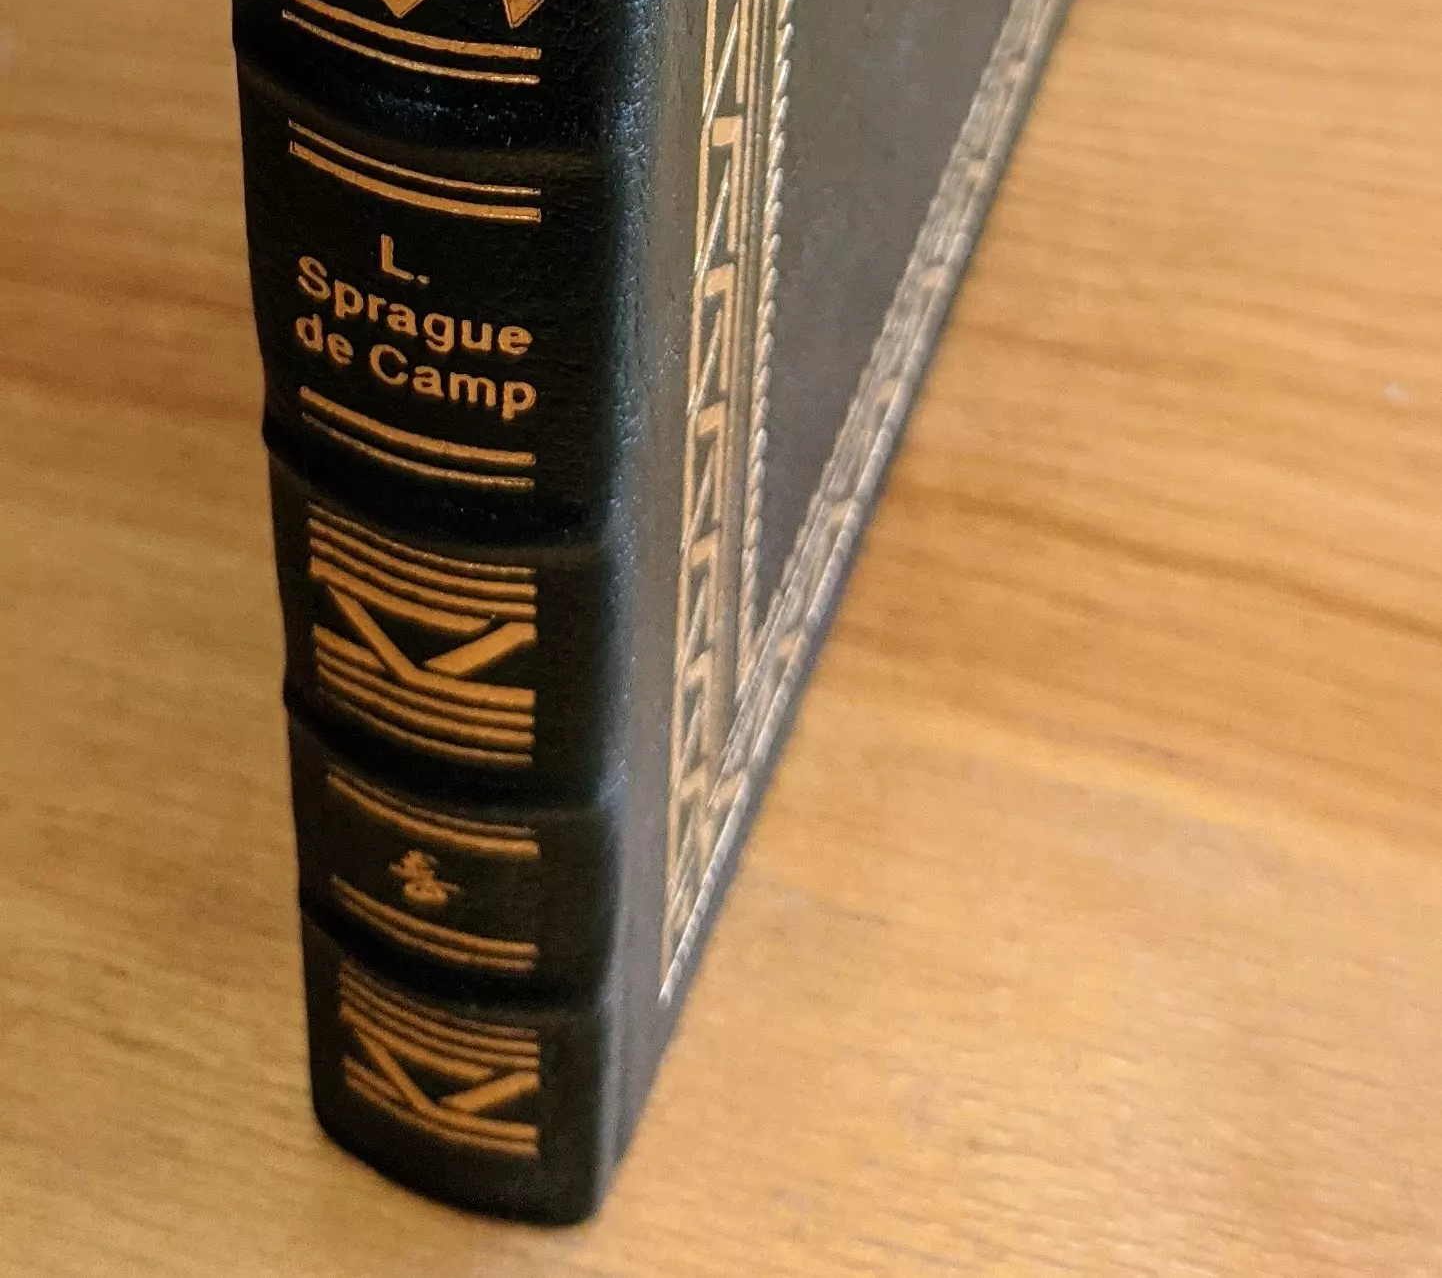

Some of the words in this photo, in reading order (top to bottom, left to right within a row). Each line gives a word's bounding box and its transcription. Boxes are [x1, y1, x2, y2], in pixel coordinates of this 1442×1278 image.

[297, 255, 533, 356] Sprague
[380, 233, 430, 285] L.
[295, 313, 354, 366] de
[369, 343, 537, 421] Camp
